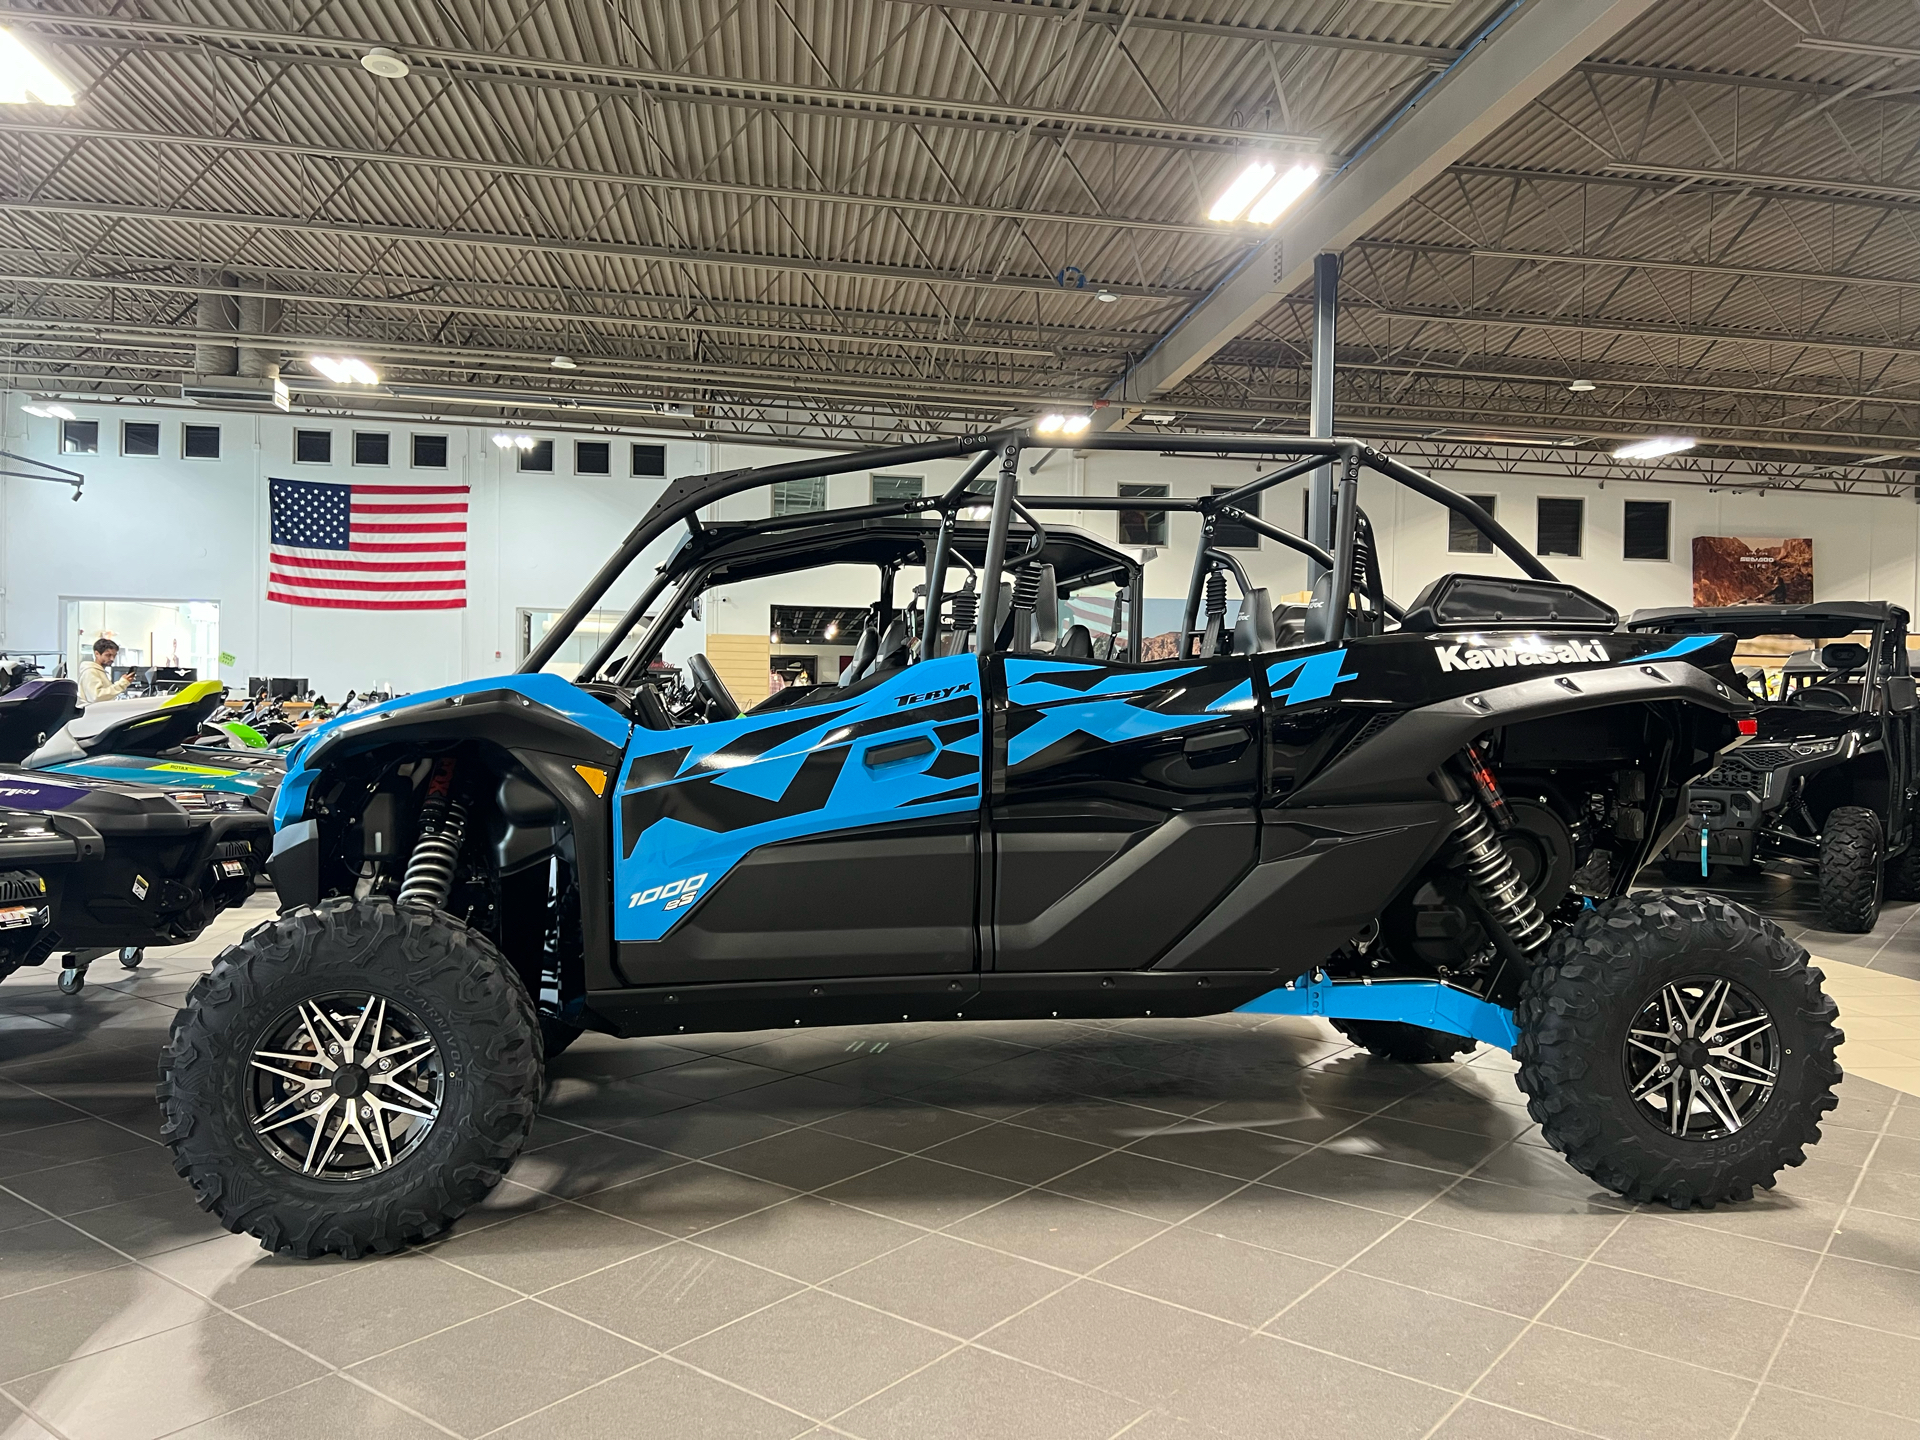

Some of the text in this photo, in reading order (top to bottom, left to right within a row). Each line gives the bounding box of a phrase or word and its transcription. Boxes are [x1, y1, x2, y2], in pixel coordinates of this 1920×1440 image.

[1434, 639, 1611, 673] Kawasaki
[894, 681, 974, 708] TERYX
[628, 872, 709, 909] 1000
[404, 988, 465, 1088] CARNIVORE
